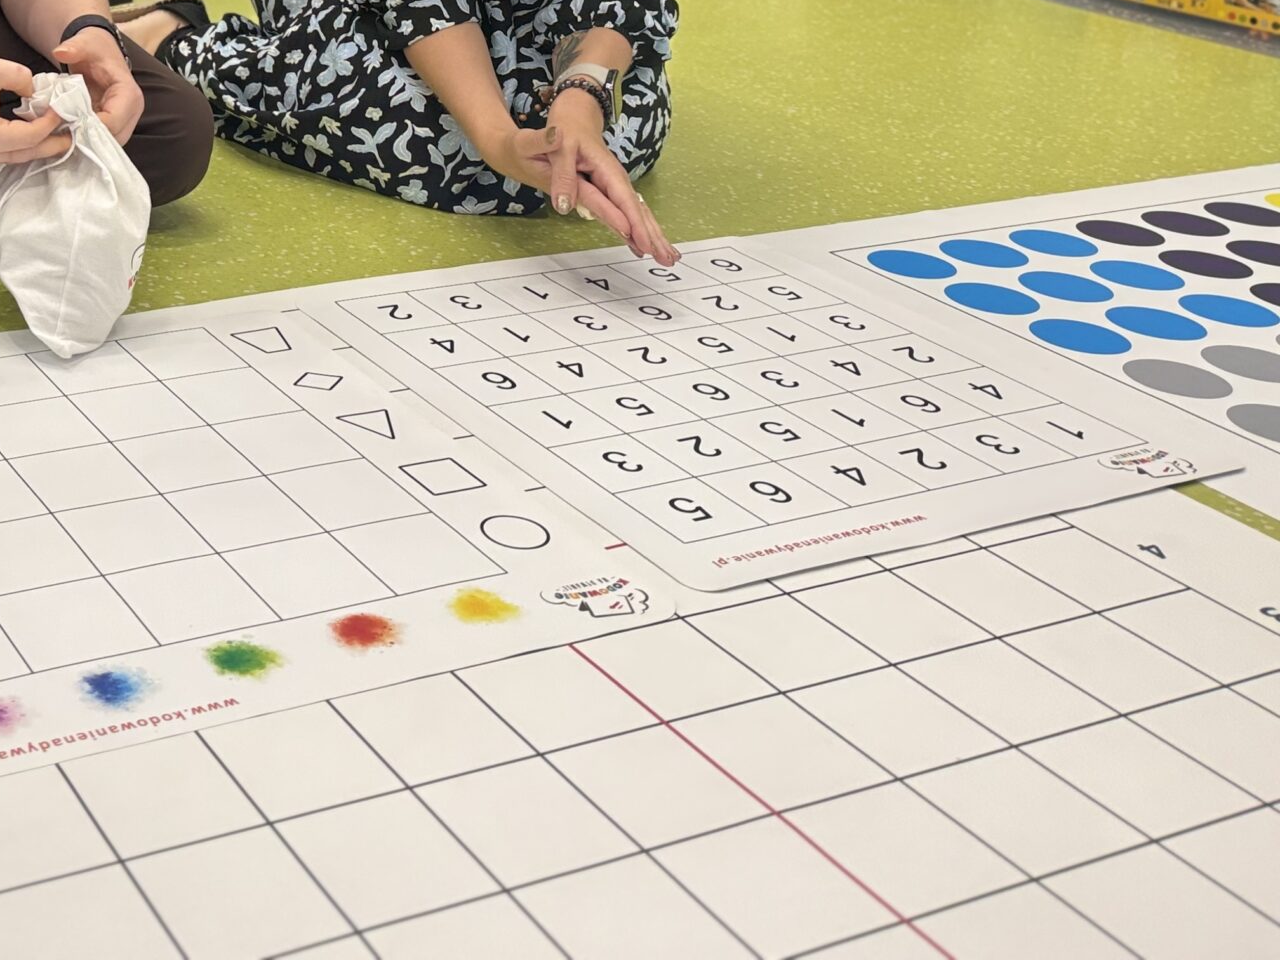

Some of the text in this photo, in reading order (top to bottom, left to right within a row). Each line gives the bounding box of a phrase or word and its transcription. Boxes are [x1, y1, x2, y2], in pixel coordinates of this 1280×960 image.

[376, 258, 743, 321] 6 5 4 1 3 2
[429, 285, 803, 354] 5 2 6 3 1 4
[480, 314, 867, 391] 3 1 5 2 4 6
[541, 345, 936, 430] 2 4 3 6 5 1
[601, 382, 1004, 473] 4 6 1 5 2 3
[668, 420, 1084, 523] 1 3 2 4 6 5
[711, 514, 927, 568] www.kodowanienadywanie.pl
[1136, 543, 1166, 559] 4
